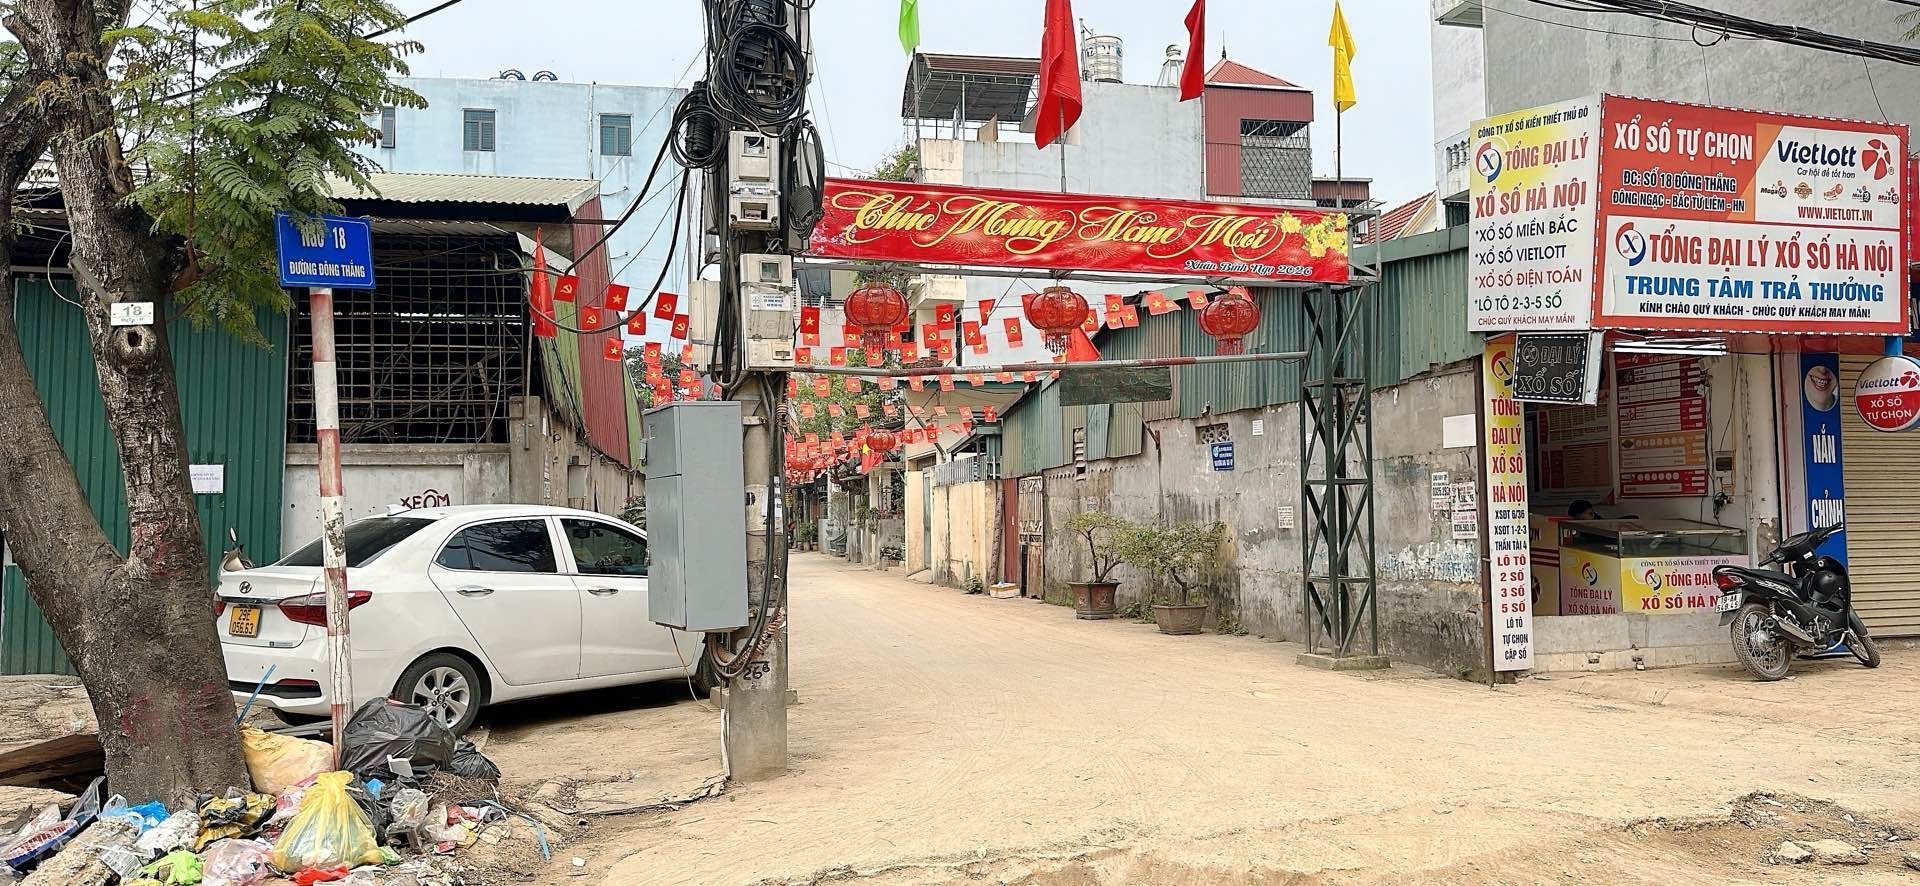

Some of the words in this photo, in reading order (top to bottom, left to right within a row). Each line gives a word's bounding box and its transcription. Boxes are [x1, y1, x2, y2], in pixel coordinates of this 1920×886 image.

[1478, 126, 1494, 138] CÔNG
[1496, 125, 1504, 135] TY
[1515, 120, 1524, 132] SỐ
[1543, 110, 1562, 125] THIẾT
[1563, 106, 1577, 121] THỦ
[1578, 105, 1589, 118] ĐÔ
[1614, 113, 1642, 151] XỔ
[1646, 119, 1673, 153] SỐ
[1677, 128, 1701, 161] TỰ
[1704, 131, 1753, 165] CHỌN
[1505, 140, 1539, 171] TỔNG
[1543, 141, 1567, 168] ĐẠI
[1571, 131, 1589, 160] LÝ
[1777, 140, 1857, 167] Vietlott
[1623, 170, 1641, 186] ĐC:
[1643, 167, 1660, 187] SỐ
[1660, 173, 1672, 187] 18
[1674, 171, 1702, 190] ĐÔNG
[1704, 172, 1736, 193] THẮNG
[1797, 167, 1807, 176] Cơ
[1808, 167, 1820, 177] hội
[1821, 165, 1830, 177] để
[1831, 168, 1841, 178] tốt
[1842, 169, 1856, 179] hơn
[1475, 185, 1496, 218] XỔ
[1500, 182, 1522, 215] SỐ
[1525, 182, 1547, 212] HÀ
[1553, 177, 1587, 212] NỘI
[1612, 189, 1638, 204] ĐÔNG
[1640, 192, 1664, 209] NGẠC
[1672, 191, 1690, 209] BẮC
[1692, 193, 1704, 209] TỪ
[1704, 195, 1725, 211] LIÊM
[1732, 199, 1745, 213] HN
[1797, 206, 1873, 222] WWW.VIETLOTT.VN
[832, 191, 942, 245] Chúc
[910, 195, 1077, 255] Mừng
[1078, 206, 1187, 244] Năm
[1146, 214, 1287, 262] Mới
[1479, 221, 1495, 242] XỔ
[1498, 221, 1513, 240] SỐ
[1516, 217, 1545, 238] MIỀN
[1549, 213, 1578, 234] BẮC
[332, 226, 346, 249] 18
[1479, 245, 1495, 265] XỔ
[1498, 245, 1513, 264] SỐ
[1516, 245, 1567, 262] VIETLOTT
[1650, 223, 1702, 264] TỔNG
[1708, 237, 1741, 272] ĐẠI
[1747, 234, 1769, 267] LÝ
[1775, 231, 1801, 269] XỔ
[1807, 234, 1831, 269] SỐ
[1836, 239, 1859, 271] HÀ
[1864, 240, 1893, 277] NỘI
[289, 259, 318, 276] ĐƯỜNG
[318, 261, 340, 277] ĐÔNG
[341, 260, 366, 277] THẮNG
[1184, 260, 1218, 271] Xuân
[1220, 261, 1249, 273] Bính
[1276, 264, 1313, 276] 2026
[1479, 269, 1495, 289] XỔ
[1498, 268, 1513, 287] SỐ
[1516, 269, 1543, 288] ĐIỆN
[1547, 265, 1582, 284] TOÁN
[1625, 275, 1700, 297] TRUNG
[1707, 275, 1753, 299] TÂM
[1760, 274, 1801, 300] TRẢ
[1808, 276, 1884, 302] THƯỞNG
[1479, 296, 1492, 311] LÔ
[1495, 295, 1509, 311] TÔ
[1512, 296, 1542, 310] 2-3-5
[1545, 289, 1562, 309] SỐ
[1640, 300, 1662, 313] KÍNH
[1665, 301, 1690, 315] CHÀO
[1693, 302, 1710, 315] QUÝ
[1713, 302, 1743, 316] KHÁCH
[1752, 304, 1776, 317] CHÚC
[1778, 304, 1796, 317] QUÝ
[1799, 305, 1827, 318] KHÁCH
[1829, 307, 1846, 318] MAY
[1849, 304, 1871, 318] MẮN!
[122, 306, 142, 317] 18
[1478, 315, 1496, 326] CHÚC
[1498, 315, 1512, 325] QUÝ
[1513, 314, 1537, 325] KHÁCH
[1538, 315, 1554, 324] MAY
[1540, 345, 1562, 367] ĐẠI
[1566, 342, 1581, 364] LÝ
[1518, 367, 1547, 394] XỔ
[1550, 370, 1580, 395] SỐ
[1860, 377, 1899, 389] Vietlott
[1491, 391, 1520, 416] TỔNG
[1871, 395, 1885, 408] XỔ
[1887, 394, 1902, 407] SỐ
[1866, 411, 1879, 422] TỰ
[1881, 409, 1912, 420] CHỌN
[1491, 427, 1508, 448] ĐẠI
[1511, 424, 1521, 444] LÝ
[1812, 423, 1836, 464] NẮN
[1492, 449, 1506, 474] XỔ
[1509, 450, 1523, 473] SỐ
[1493, 482, 1506, 503] HÀ
[1508, 481, 1526, 506] NỘI
[1811, 489, 1843, 529] CHỈNH
[1511, 525, 1527, 535] 1-2-3
[1512, 538, 1522, 550] TÀI
[1523, 540, 1527, 550] 4
[1497, 554, 1510, 566] LÔ
[1513, 554, 1526, 566] TÔ
[1500, 572, 1507, 582] 2
[1510, 568, 1524, 581] SỐ
[1665, 569, 1692, 587] TỔNG
[1694, 573, 1712, 588] ĐẠI
[1501, 588, 1507, 597] 3
[1511, 583, 1525, 597] SỐ
[1570, 585, 1588, 598] TỔNG
[1590, 590, 1602, 601] ĐẠI
[1604, 588, 1612, 600] LÝ
[1501, 603, 1508, 613] 5
[1511, 599, 1526, 612] SỐ
[1579, 601, 1589, 615] SỐ
[1590, 604, 1601, 614] HÀ
[1642, 592, 1660, 610] XỔ
[1665, 592, 1683, 609] SỐ
[1687, 593, 1706, 608] HÀ
[239, 609, 252, 621] 29E
[1506, 616, 1514, 629] LÔ
[1515, 616, 1523, 628] TÔ
[232, 621, 254, 634] 056.63
[1502, 633, 1511, 647] TỰ
[1511, 633, 1528, 646] CHỌN
[1518, 646, 1527, 659] SỐ
